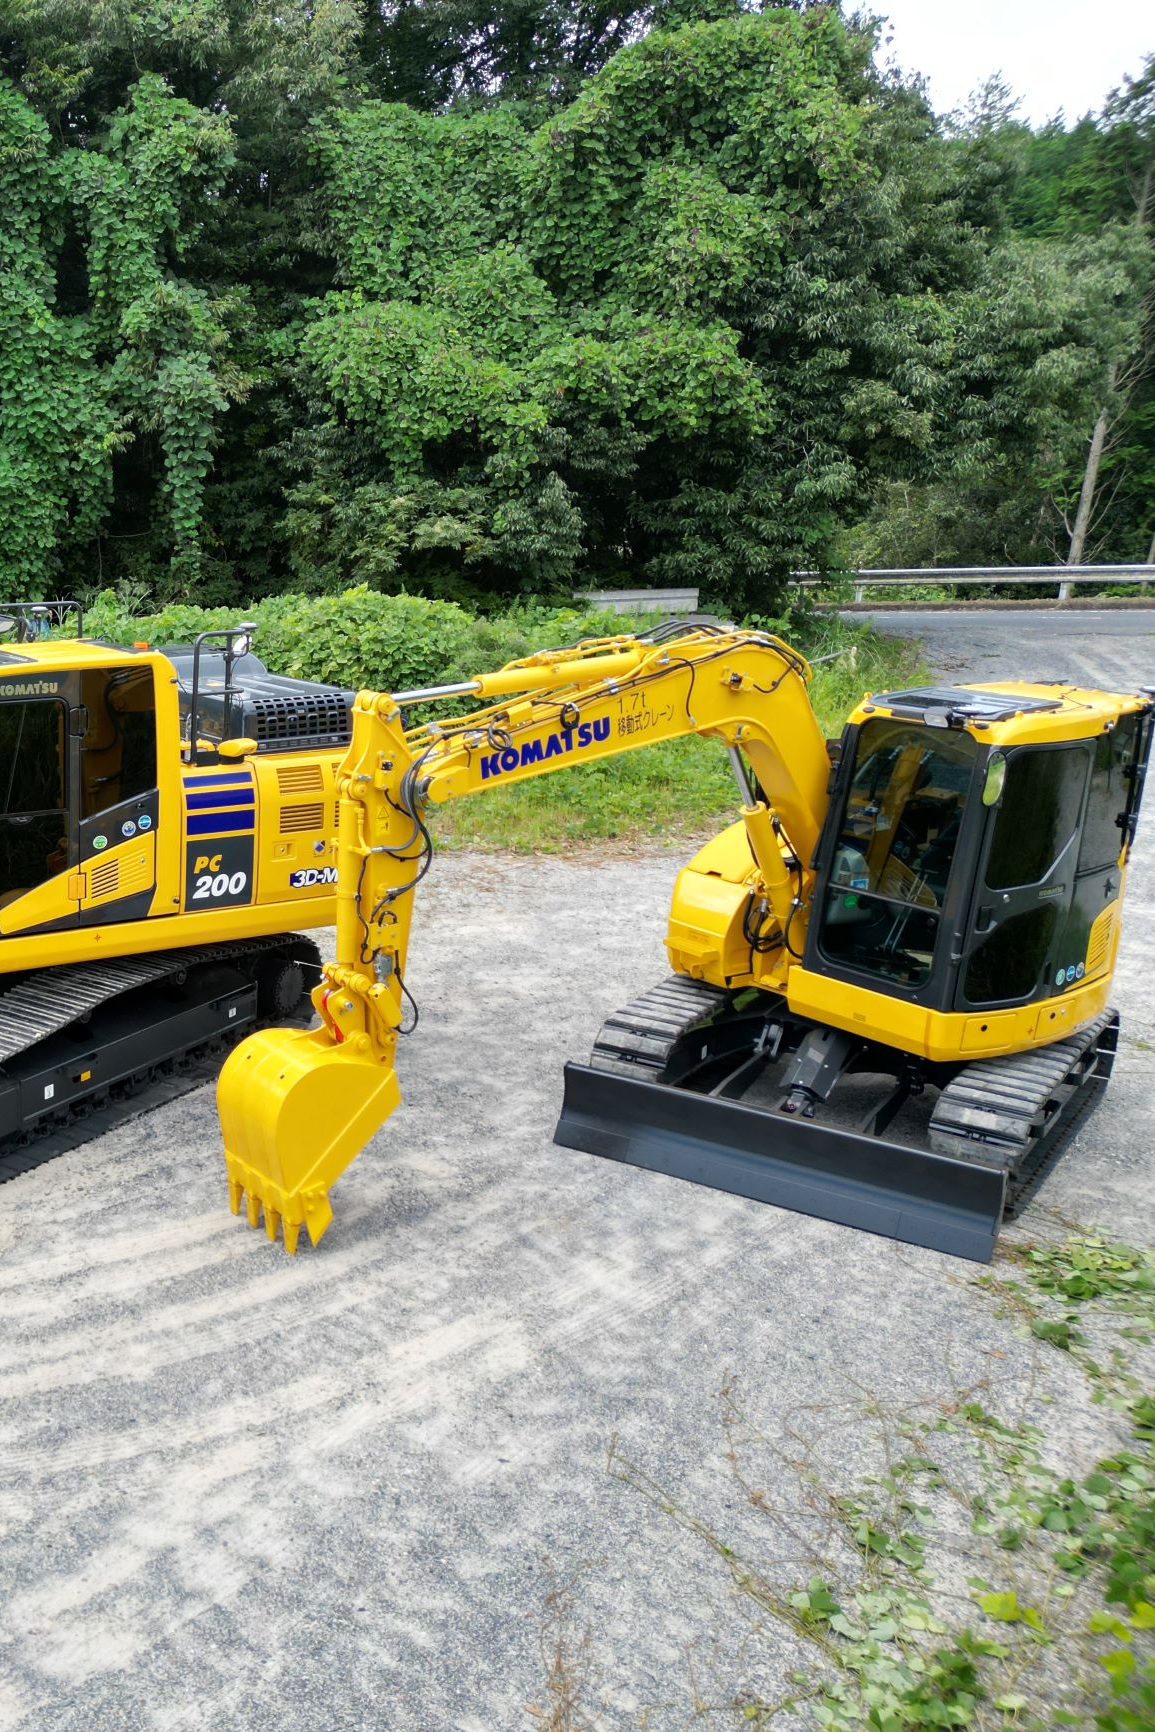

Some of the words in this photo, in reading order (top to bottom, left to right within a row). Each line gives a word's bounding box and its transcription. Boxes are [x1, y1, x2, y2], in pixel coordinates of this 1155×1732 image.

[617, 691, 646, 714] 1.7t
[618, 704, 674, 737] 移動式クレーン
[480, 716, 611, 779] KOMATSU
[194, 854, 223, 875] PC
[192, 871, 247, 899] 200
